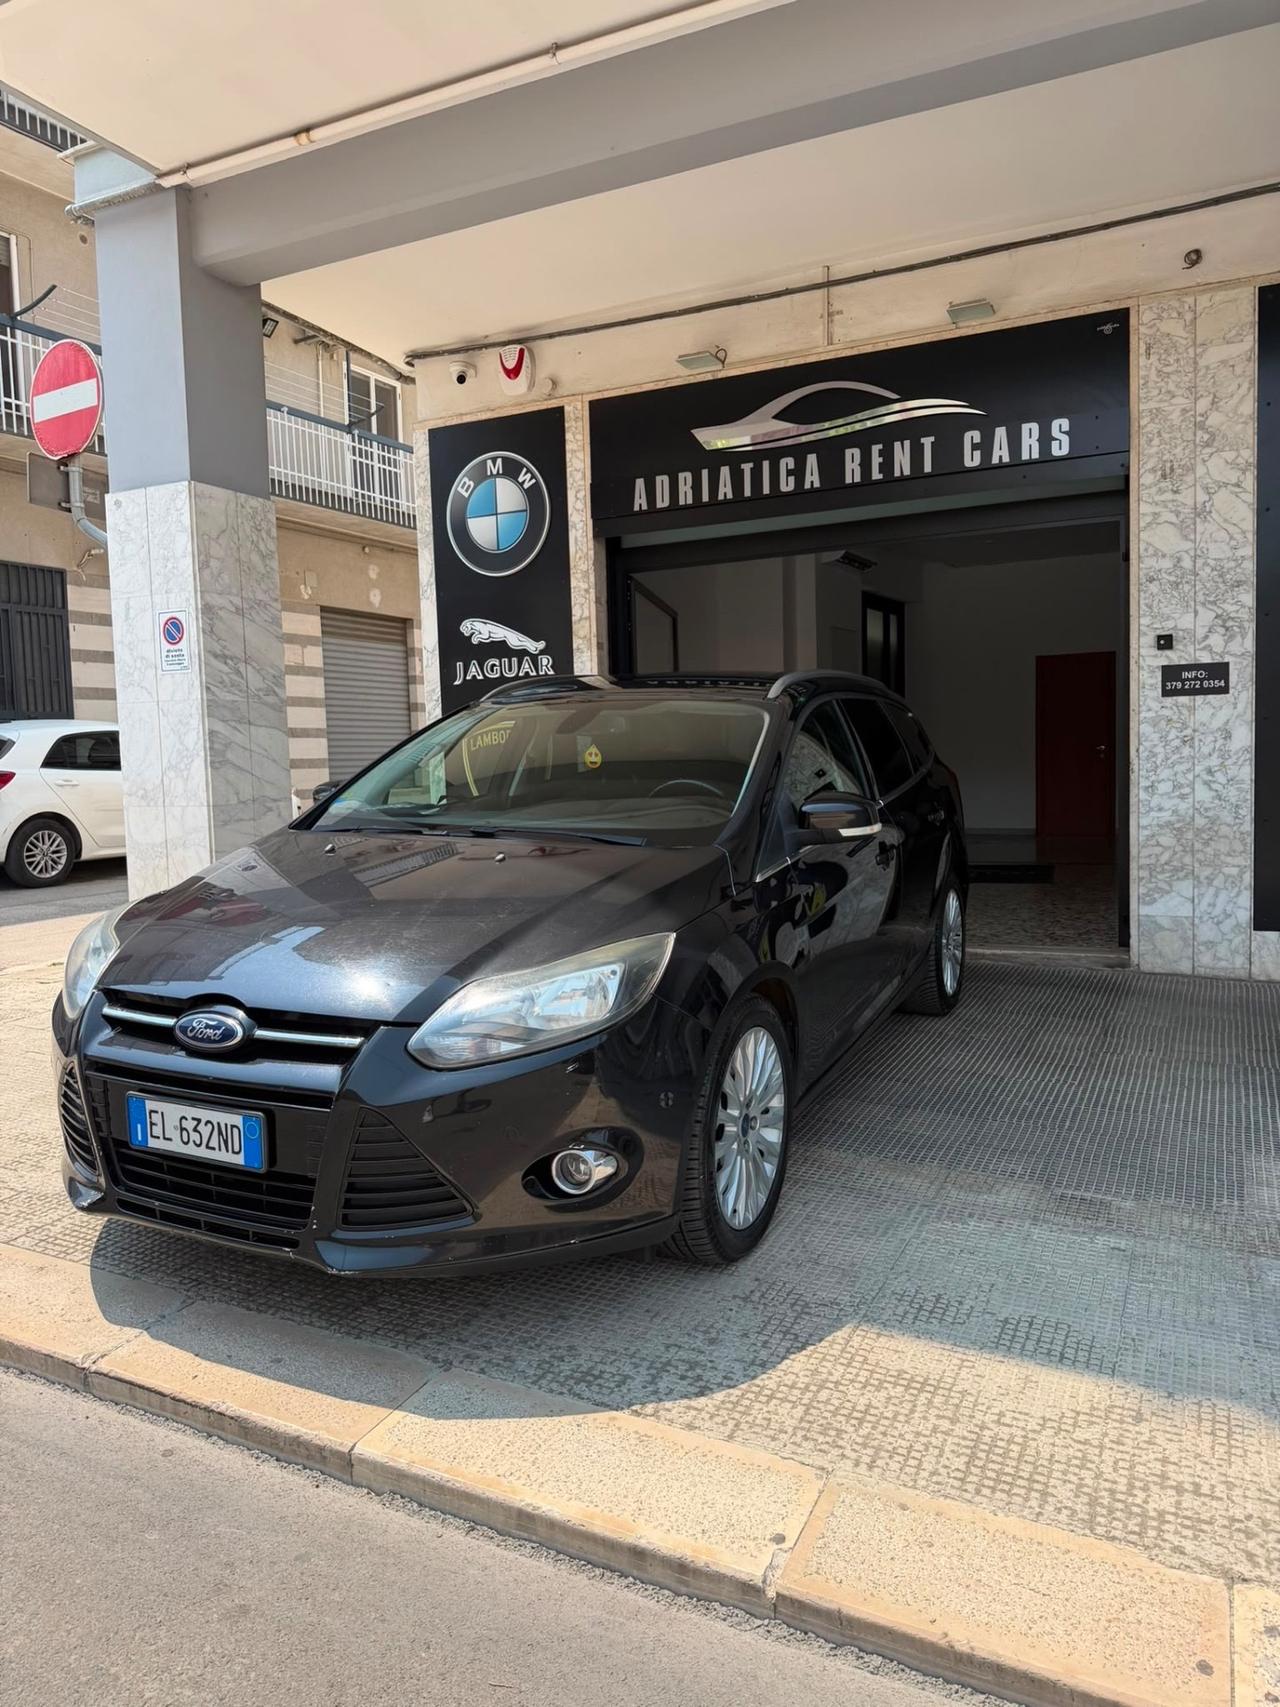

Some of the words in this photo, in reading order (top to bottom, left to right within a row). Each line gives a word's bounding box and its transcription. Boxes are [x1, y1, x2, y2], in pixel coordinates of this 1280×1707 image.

[457, 457, 536, 499] BMW
[633, 453, 821, 511] ADRIATICA
[844, 436, 935, 484] RENT
[963, 418, 1070, 468] CARS
[453, 655, 556, 686] JAGUAR
[1181, 670, 1209, 679] INFO:
[1165, 681, 1182, 690] 379
[1184, 680, 1201, 689] 272
[1203, 679, 1226, 688] 0354
[187, 1018, 226, 1041] Ford
